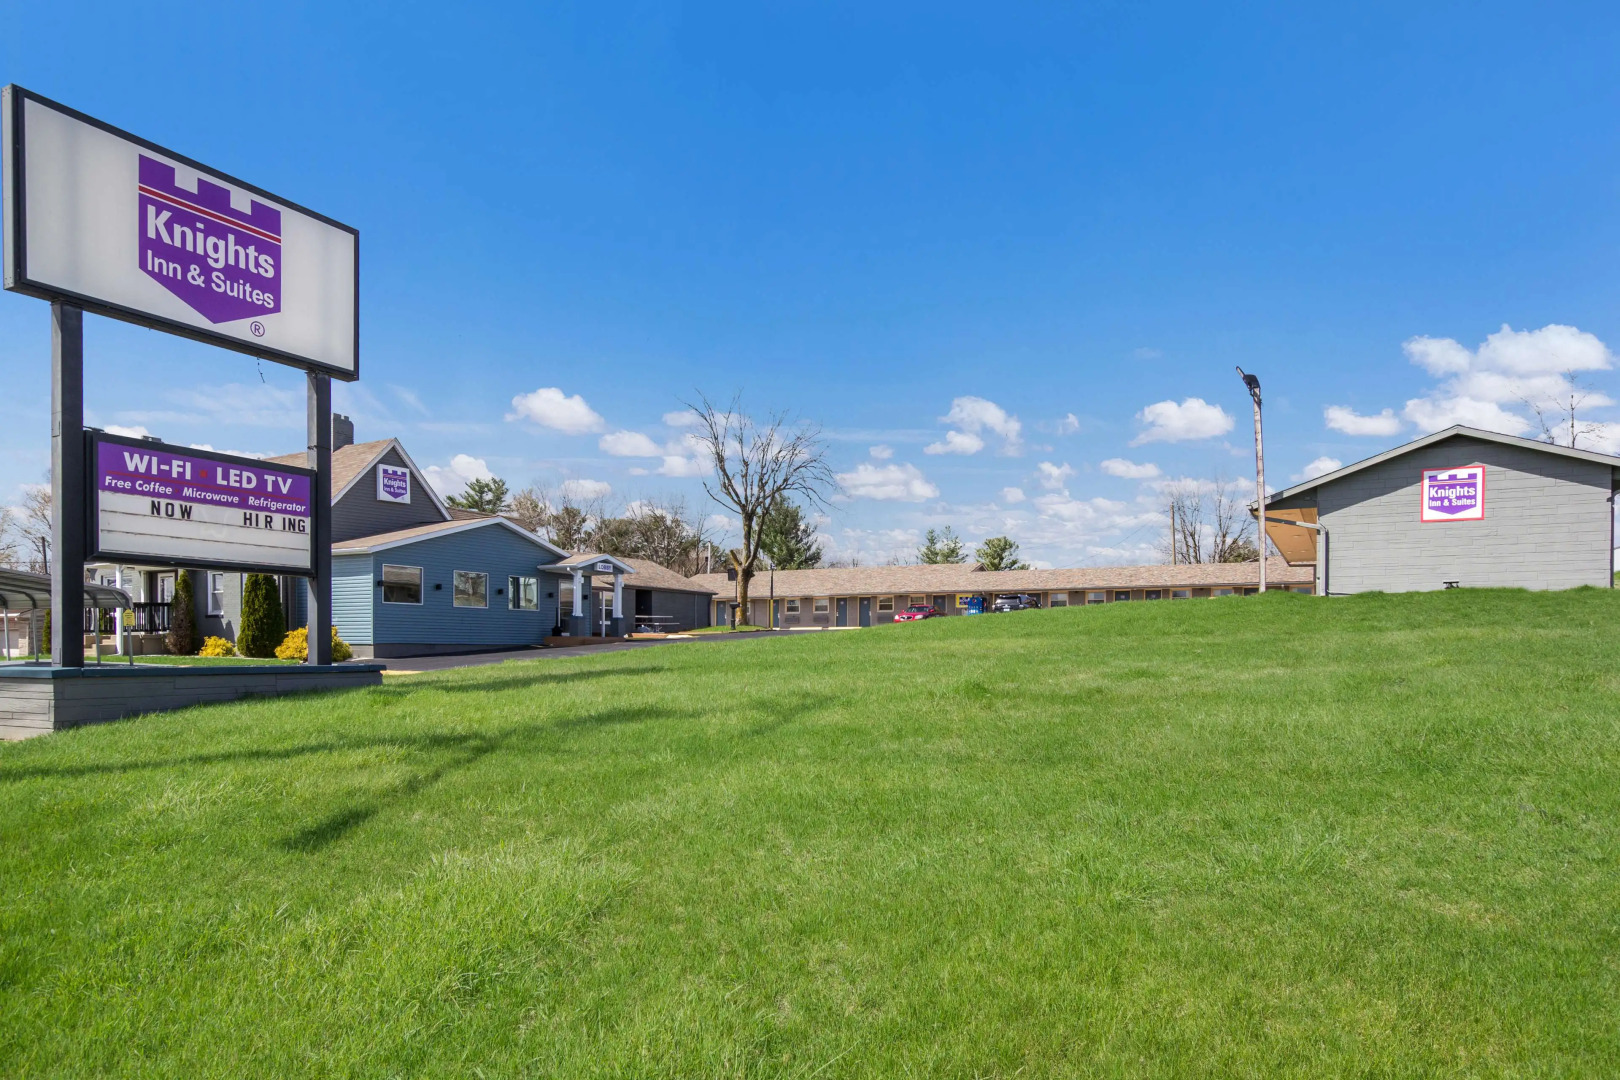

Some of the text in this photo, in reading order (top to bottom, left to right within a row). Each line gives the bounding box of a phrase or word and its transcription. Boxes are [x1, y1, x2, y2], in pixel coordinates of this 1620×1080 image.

[147, 204, 275, 278] Knights
[146, 249, 275, 309] Inn & Suites
[123, 451, 293, 495] WI-FI LED TV
[384, 477, 406, 487] Knights
[105, 475, 307, 513] Free Coffee Microwave Refrigerator
[1429, 486, 1475, 499] Knights
[1443, 499, 1450, 507] &
[1452, 498, 1475, 506] Suites
[151, 500, 193, 520] NOW
